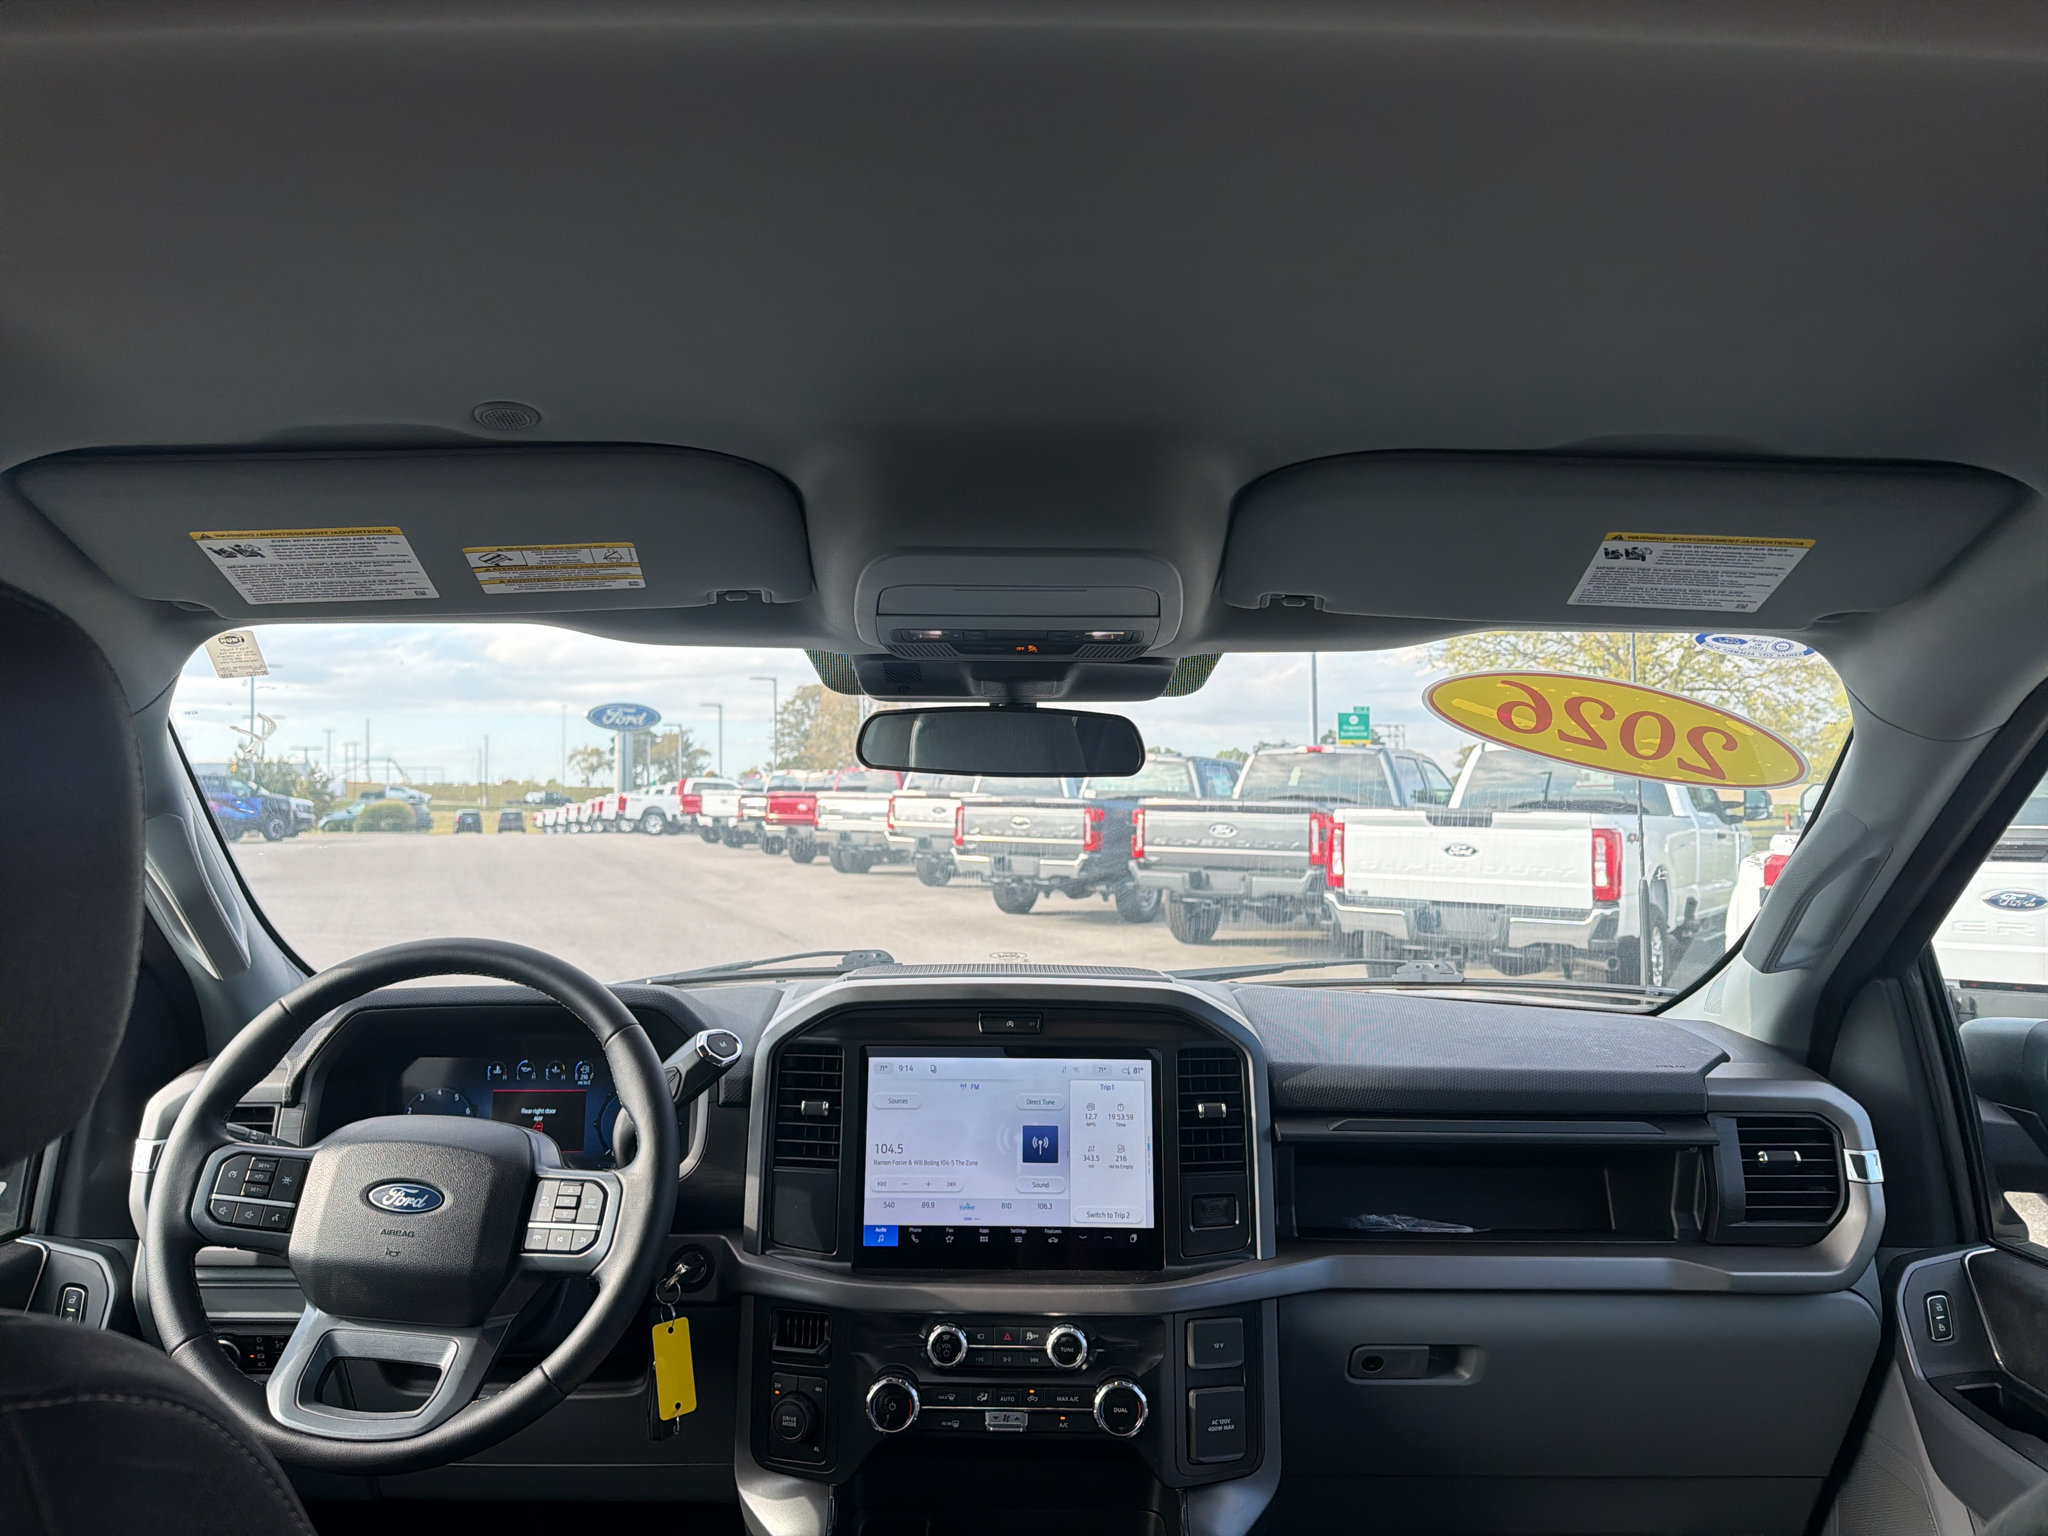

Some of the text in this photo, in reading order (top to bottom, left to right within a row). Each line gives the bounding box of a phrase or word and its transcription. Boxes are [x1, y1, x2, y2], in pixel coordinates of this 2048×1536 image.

[602, 707, 648, 726] Ford
[1999, 892, 2036, 907] Ford
[1100, 1084, 1111, 1092] Trip
[875, 1144, 904, 1154] 104.5
[382, 1187, 429, 1208] Ford
[1114, 1212, 1126, 1220] Trip
[381, 1228, 415, 1238] AIRBAG
